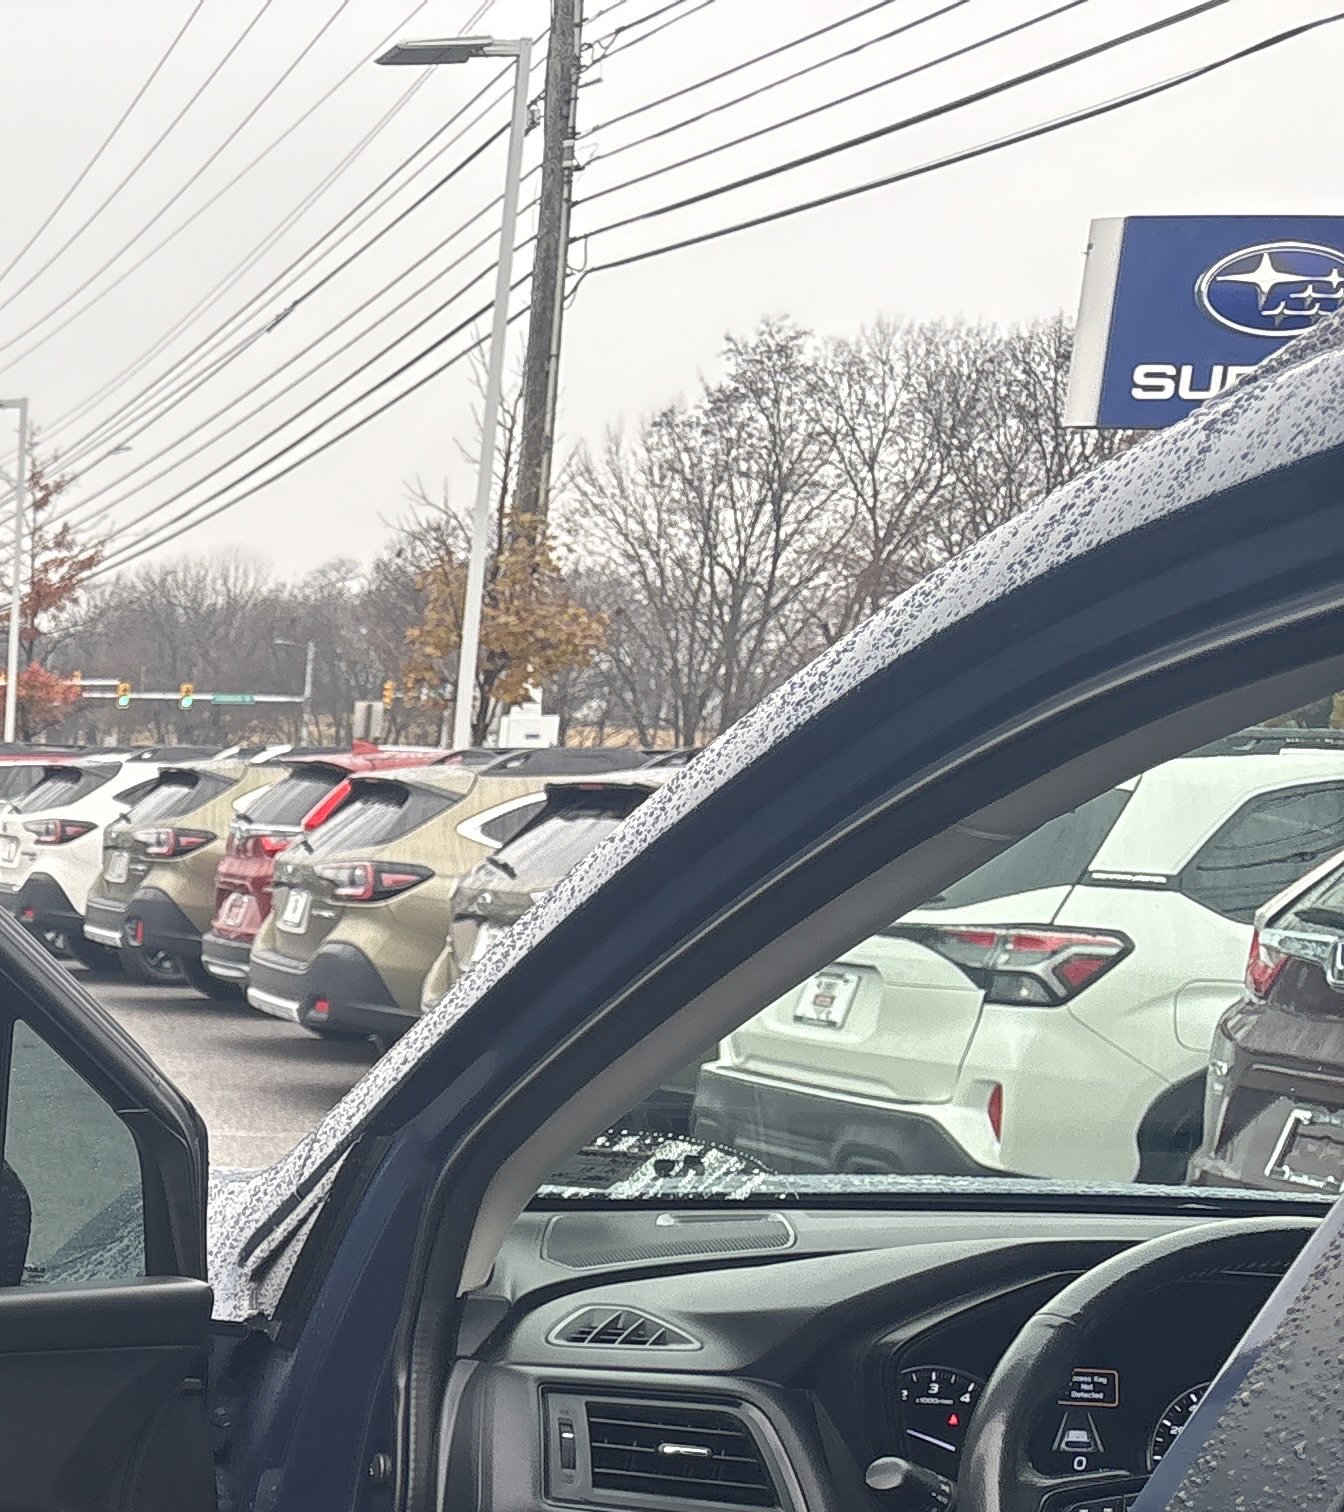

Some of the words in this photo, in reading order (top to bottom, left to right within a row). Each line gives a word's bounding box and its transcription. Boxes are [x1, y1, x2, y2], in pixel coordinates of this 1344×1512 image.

[1131, 364, 1260, 401] SU
[928, 1383, 940, 1394] 3
[960, 1393, 971, 1403] 4
[1073, 1455, 1088, 1471] 0
